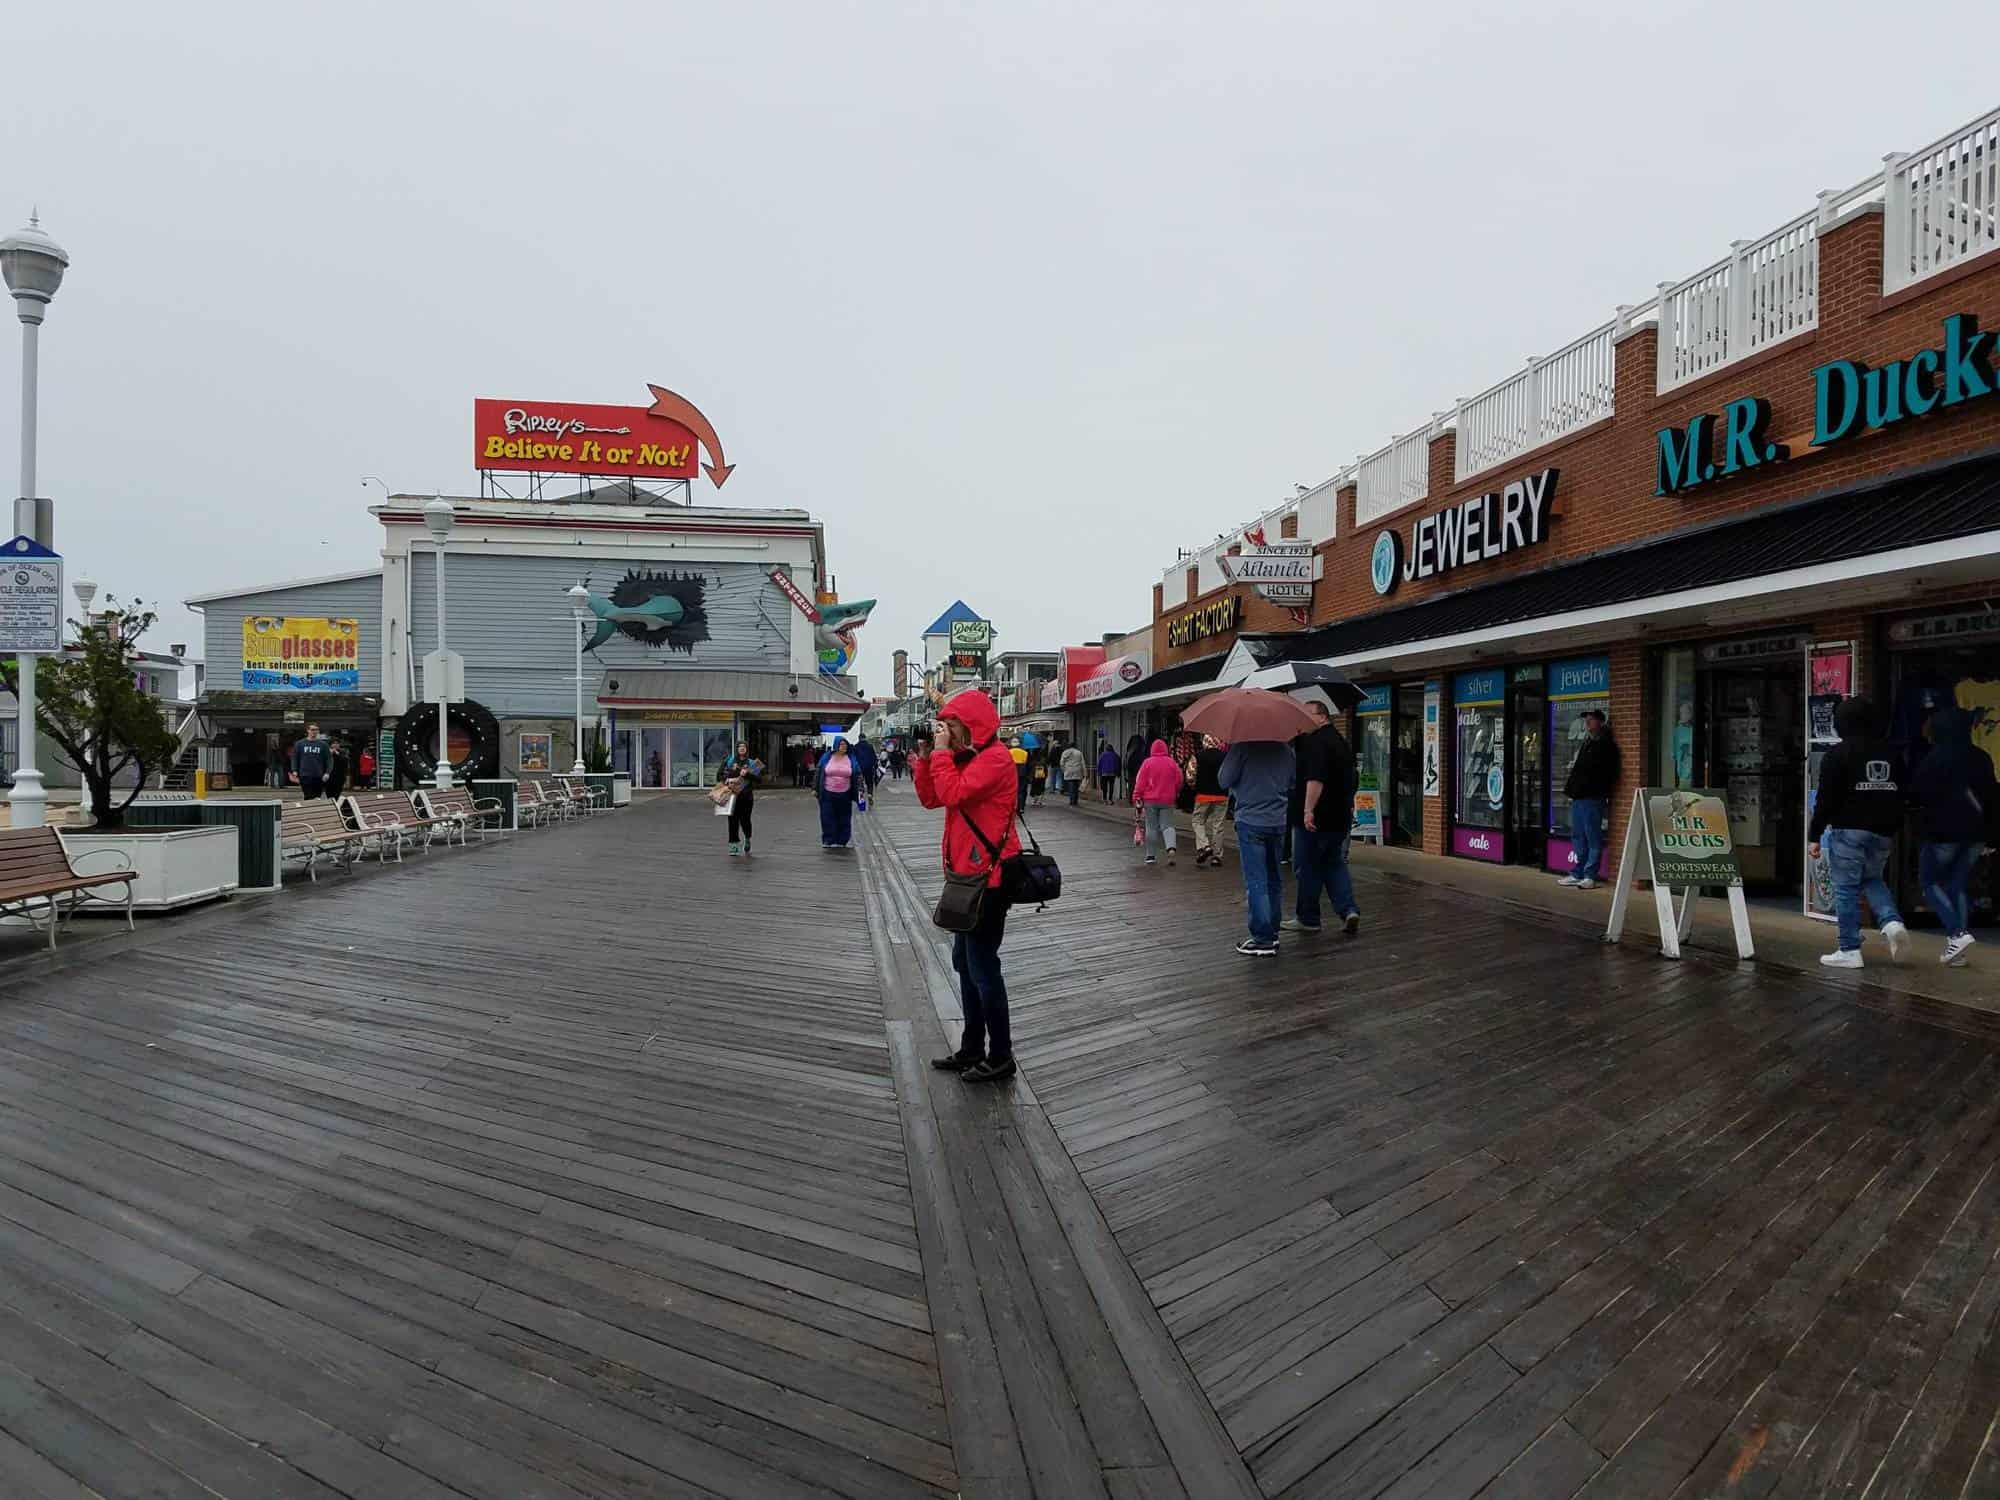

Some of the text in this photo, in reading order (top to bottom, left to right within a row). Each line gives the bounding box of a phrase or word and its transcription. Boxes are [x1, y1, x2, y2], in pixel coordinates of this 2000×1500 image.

[484, 436, 690, 467] Believe It or Not!
[1653, 395, 1778, 497] M.R.
[1403, 468, 1550, 583] JEWELRY
[1256, 546, 1288, 555] SINCE
[1236, 560, 1311, 577] Atlantic
[1266, 584, 1310, 596] HOTEL
[1167, 594, 1237, 648] T-SHIRT FACTORY
[246, 633, 355, 660] Sunglasses
[246, 659, 355, 671] Best selection anywhere
[247, 672, 255, 685] 2
[1467, 677, 1494, 696] silver
[1560, 663, 1606, 692] jewelry
[1457, 707, 1482, 726] sale
[1468, 834, 1491, 850] sale
[1663, 833, 1725, 848] DUCKS
[1658, 862, 1737, 873] SPORTSWEAR
